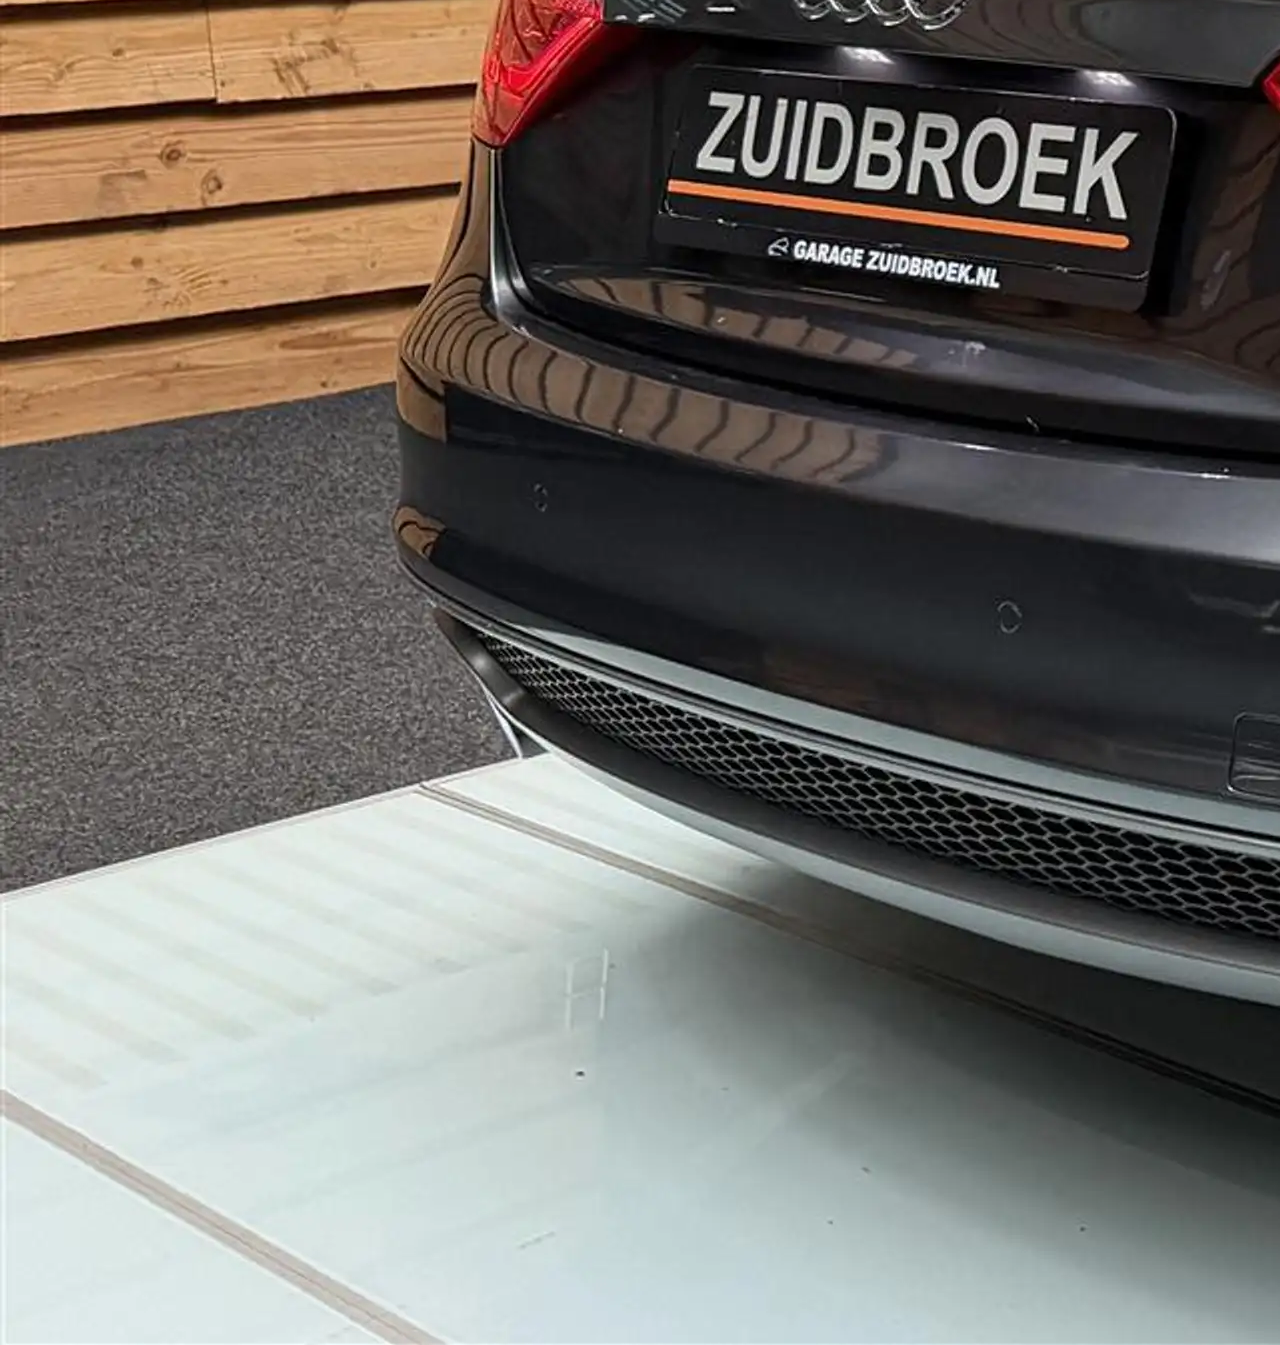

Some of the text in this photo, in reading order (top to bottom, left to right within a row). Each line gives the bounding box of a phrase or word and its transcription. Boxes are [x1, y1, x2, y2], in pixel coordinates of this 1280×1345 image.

[697, 91, 1139, 221] ZUIDBROEK
[794, 240, 1001, 290] GARAGE ZUIDBROEK.NL
